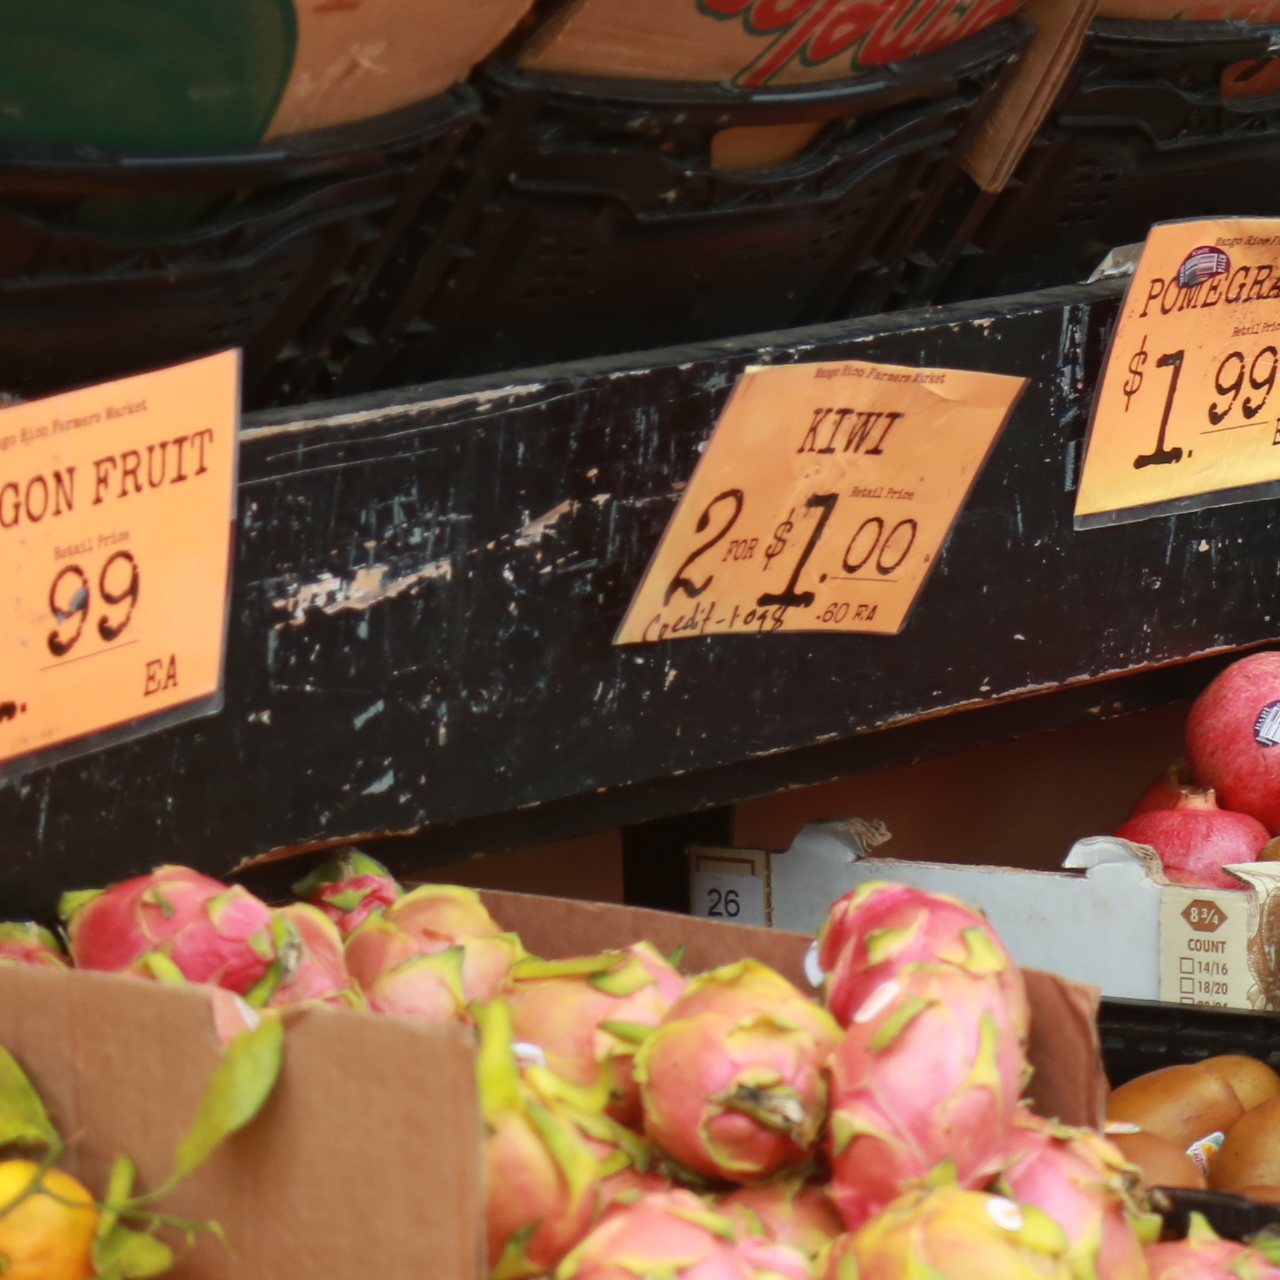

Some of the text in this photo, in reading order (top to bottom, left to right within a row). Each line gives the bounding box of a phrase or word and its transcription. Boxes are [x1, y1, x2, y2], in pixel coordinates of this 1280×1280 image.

[1215, 236, 1242, 249] Mango
[1231, 324, 1260, 338] Retail
[842, 365, 863, 378] Rico
[865, 367, 912, 383] Farmers
[912, 371, 946, 384] Market
[105, 399, 148, 421] Market
[796, 407, 905, 456] KIWI
[91, 428, 214, 506] FRUIT
[850, 486, 915, 501] Retail Price
[53, 530, 131, 561] Retail Price
[662, 488, 744, 607] 2
[721, 538, 758, 562] FOR
[852, 603, 878, 622] EA
[143, 653, 179, 697] EA
[707, 887, 741, 917] 26
[1187, 938, 1227, 955] COUNT
[1197, 960, 1229, 976] 14/16
[1197, 980, 1229, 996] 18/20
